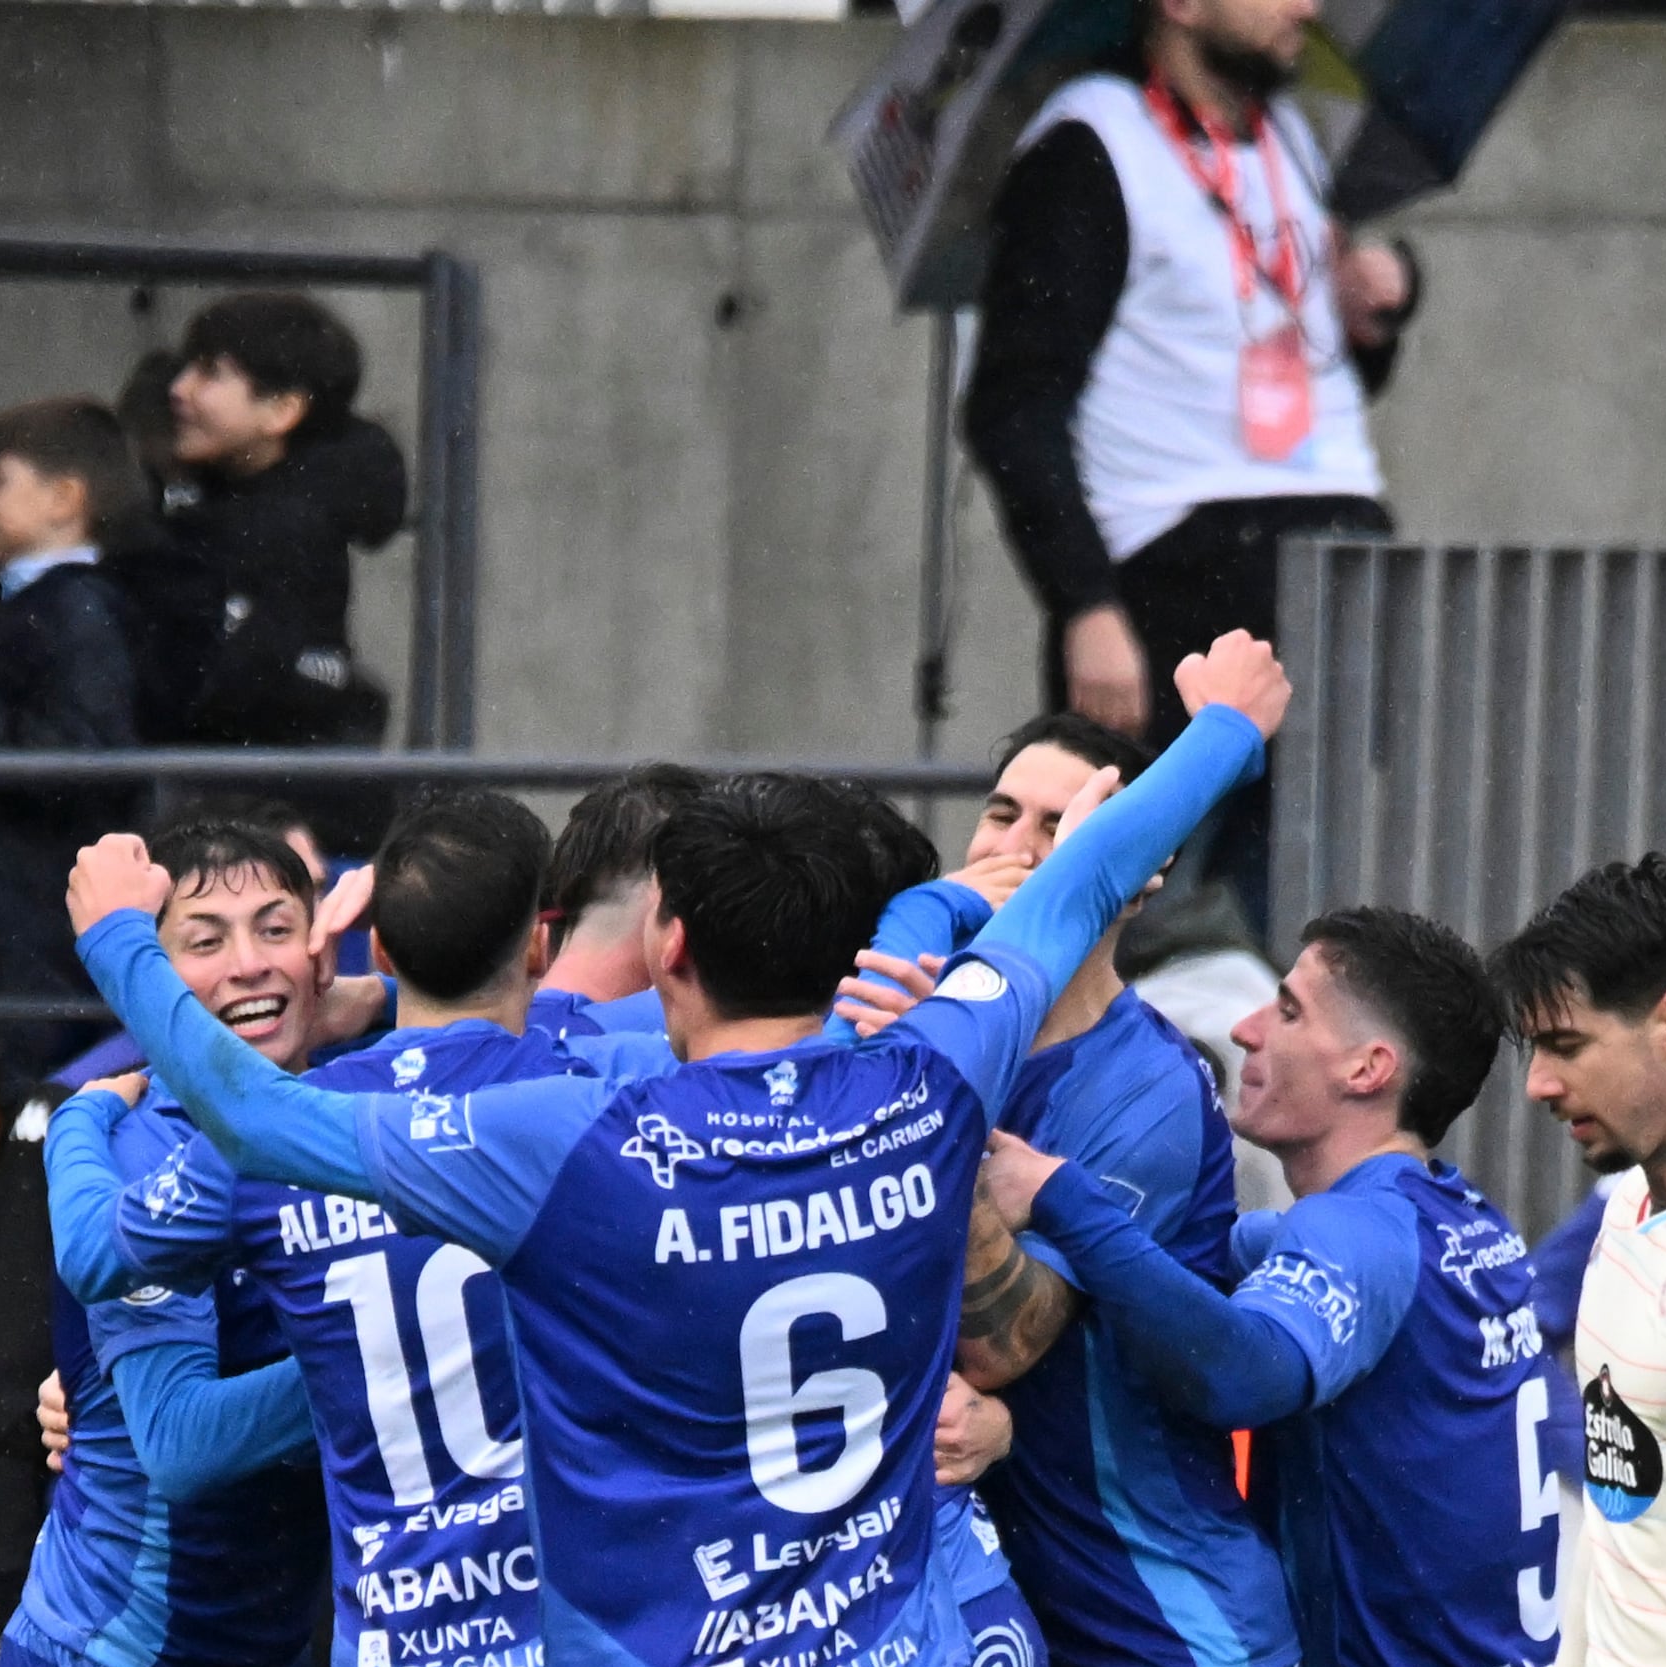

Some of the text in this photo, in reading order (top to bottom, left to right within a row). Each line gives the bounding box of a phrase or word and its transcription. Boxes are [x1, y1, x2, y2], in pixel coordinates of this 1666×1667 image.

[655, 1164, 936, 1264] A. FIDALGO
[830, 1109, 944, 1169] EL CARMEN
[323, 1244, 527, 1508] 10
[739, 1271, 889, 1514] 6
[1516, 1377, 1560, 1643] 5
[398, 1615, 516, 1660] XUNTA
